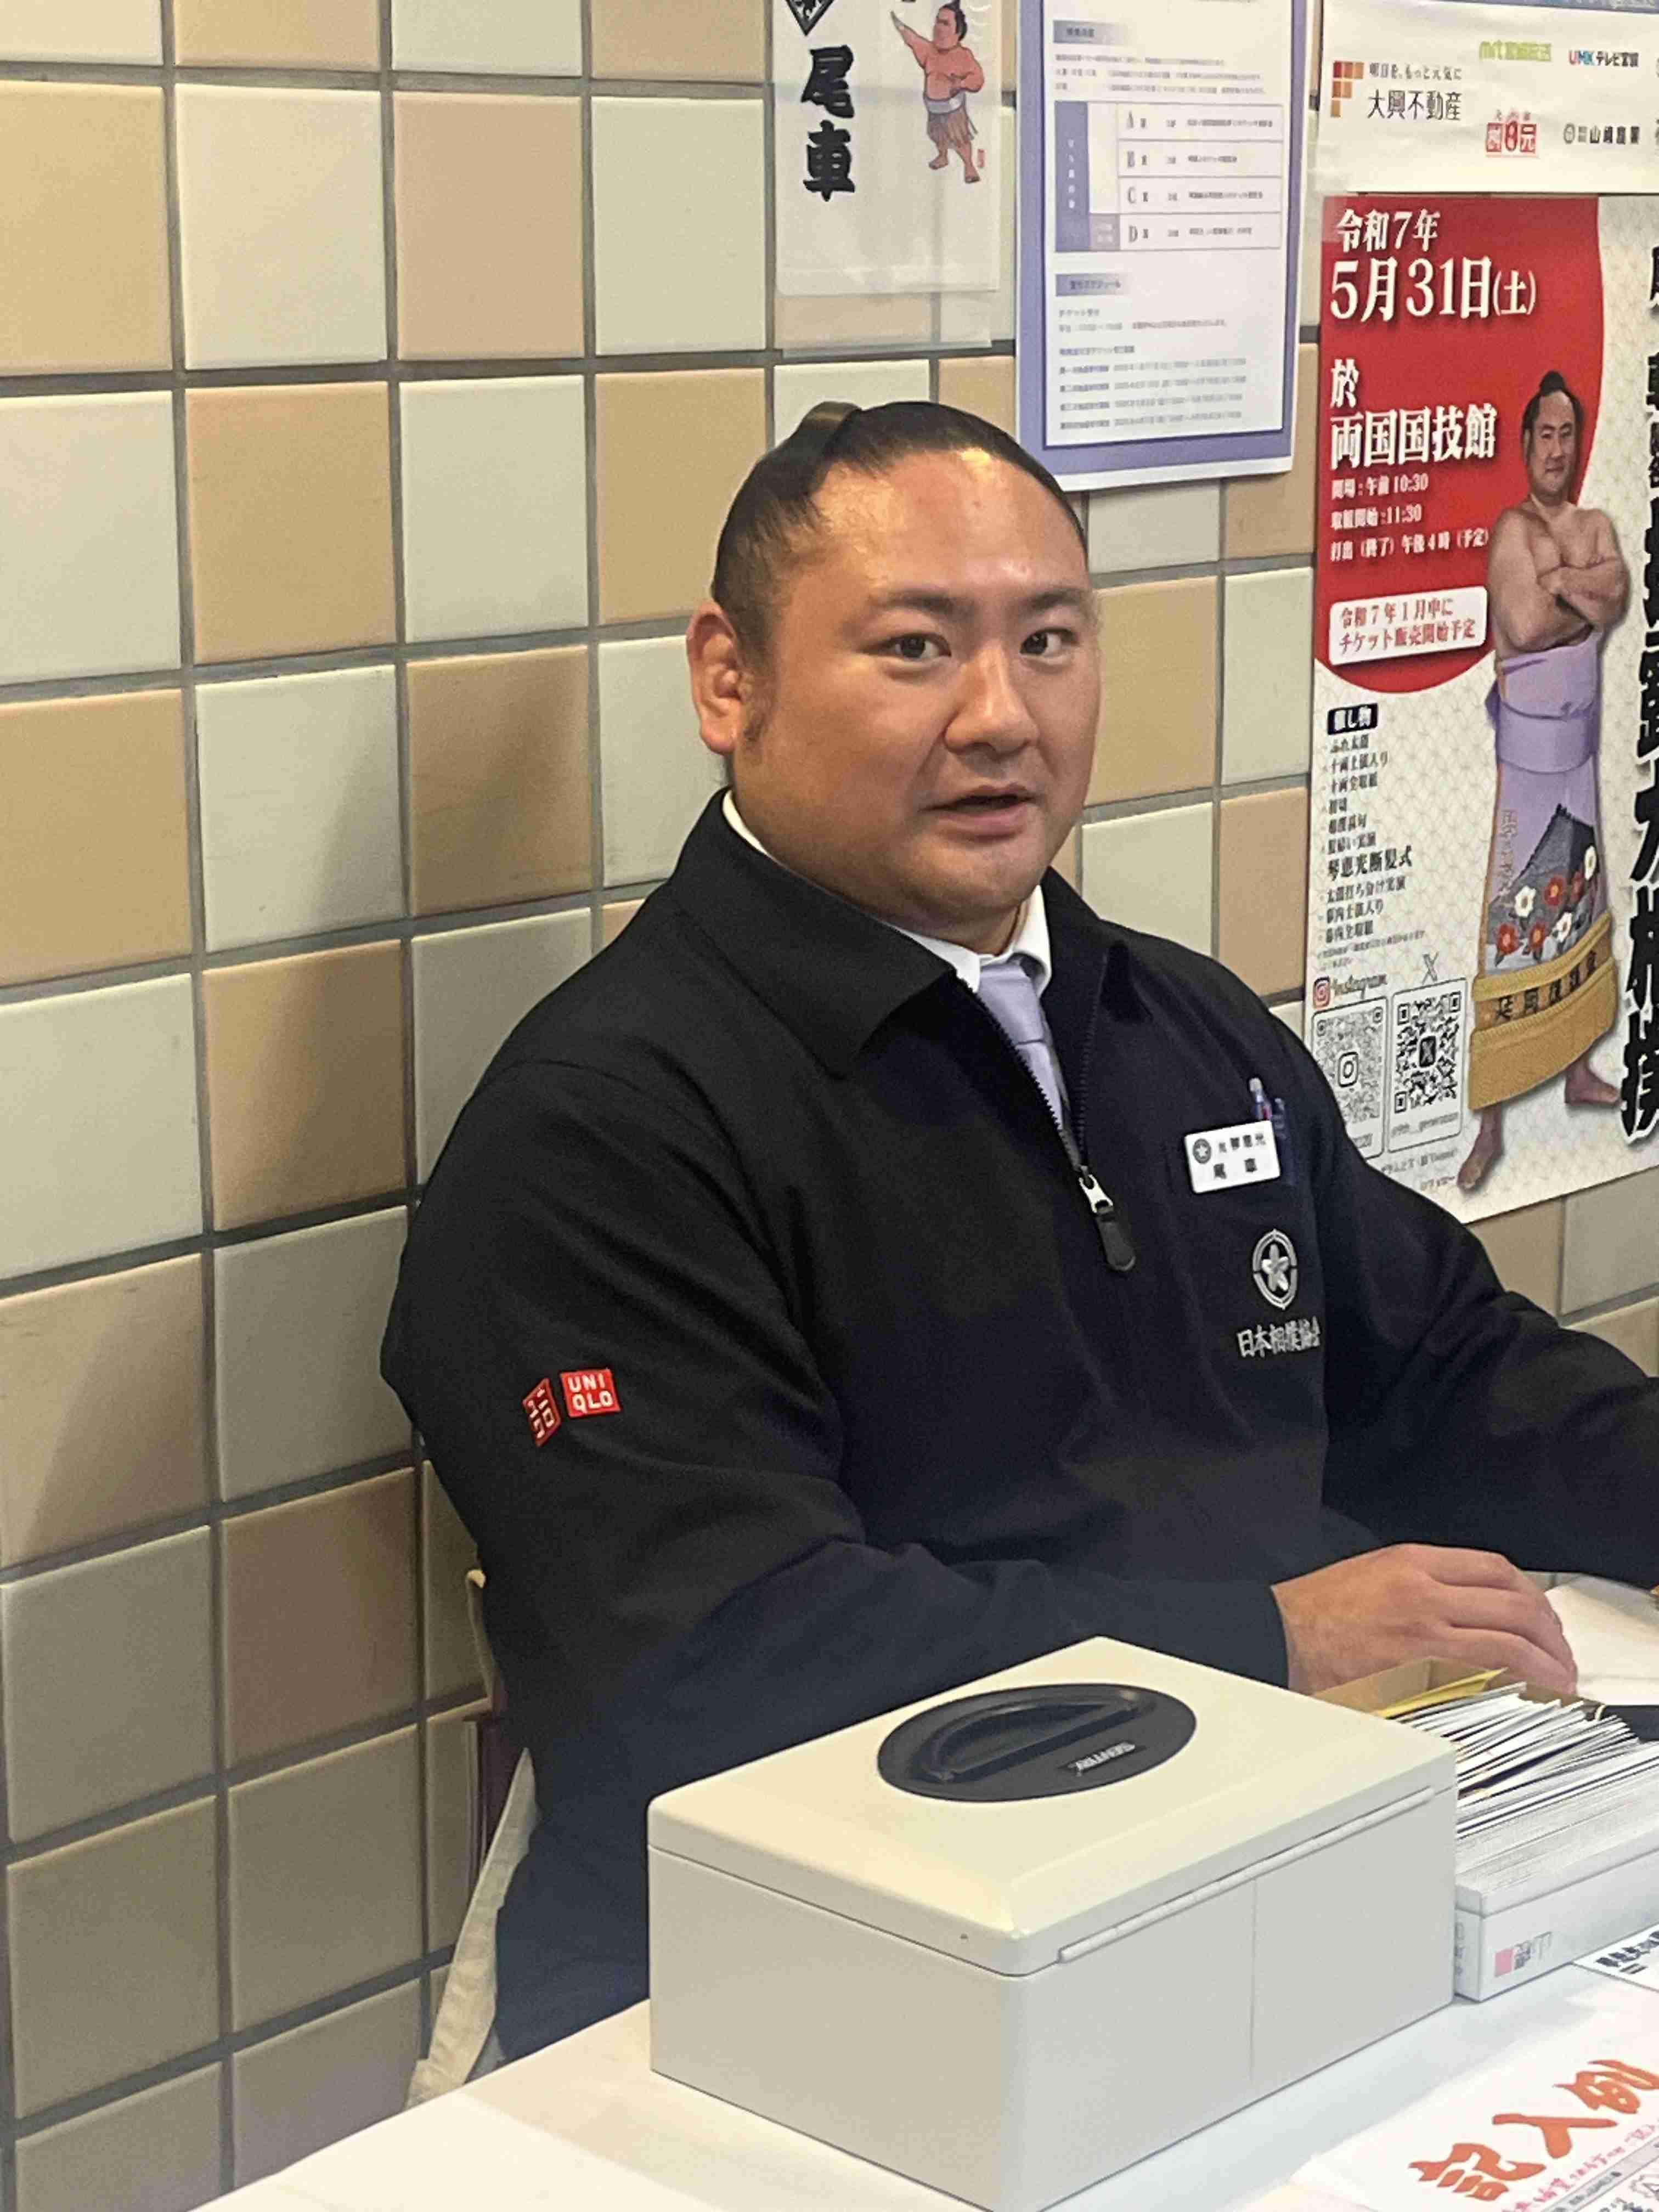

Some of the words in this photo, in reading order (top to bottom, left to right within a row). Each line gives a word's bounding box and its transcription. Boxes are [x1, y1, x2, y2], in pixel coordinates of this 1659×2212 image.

[801, 45, 855, 201] 尾車
[1368, 89, 1462, 121] 大興不動産
[1336, 208, 1440, 252] 令和7年
[1330, 358, 1359, 408] 於
[1330, 403, 1497, 470] 両国国技館
[567, 1373, 605, 1392] UNI
[572, 1390, 613, 1414] QLO
